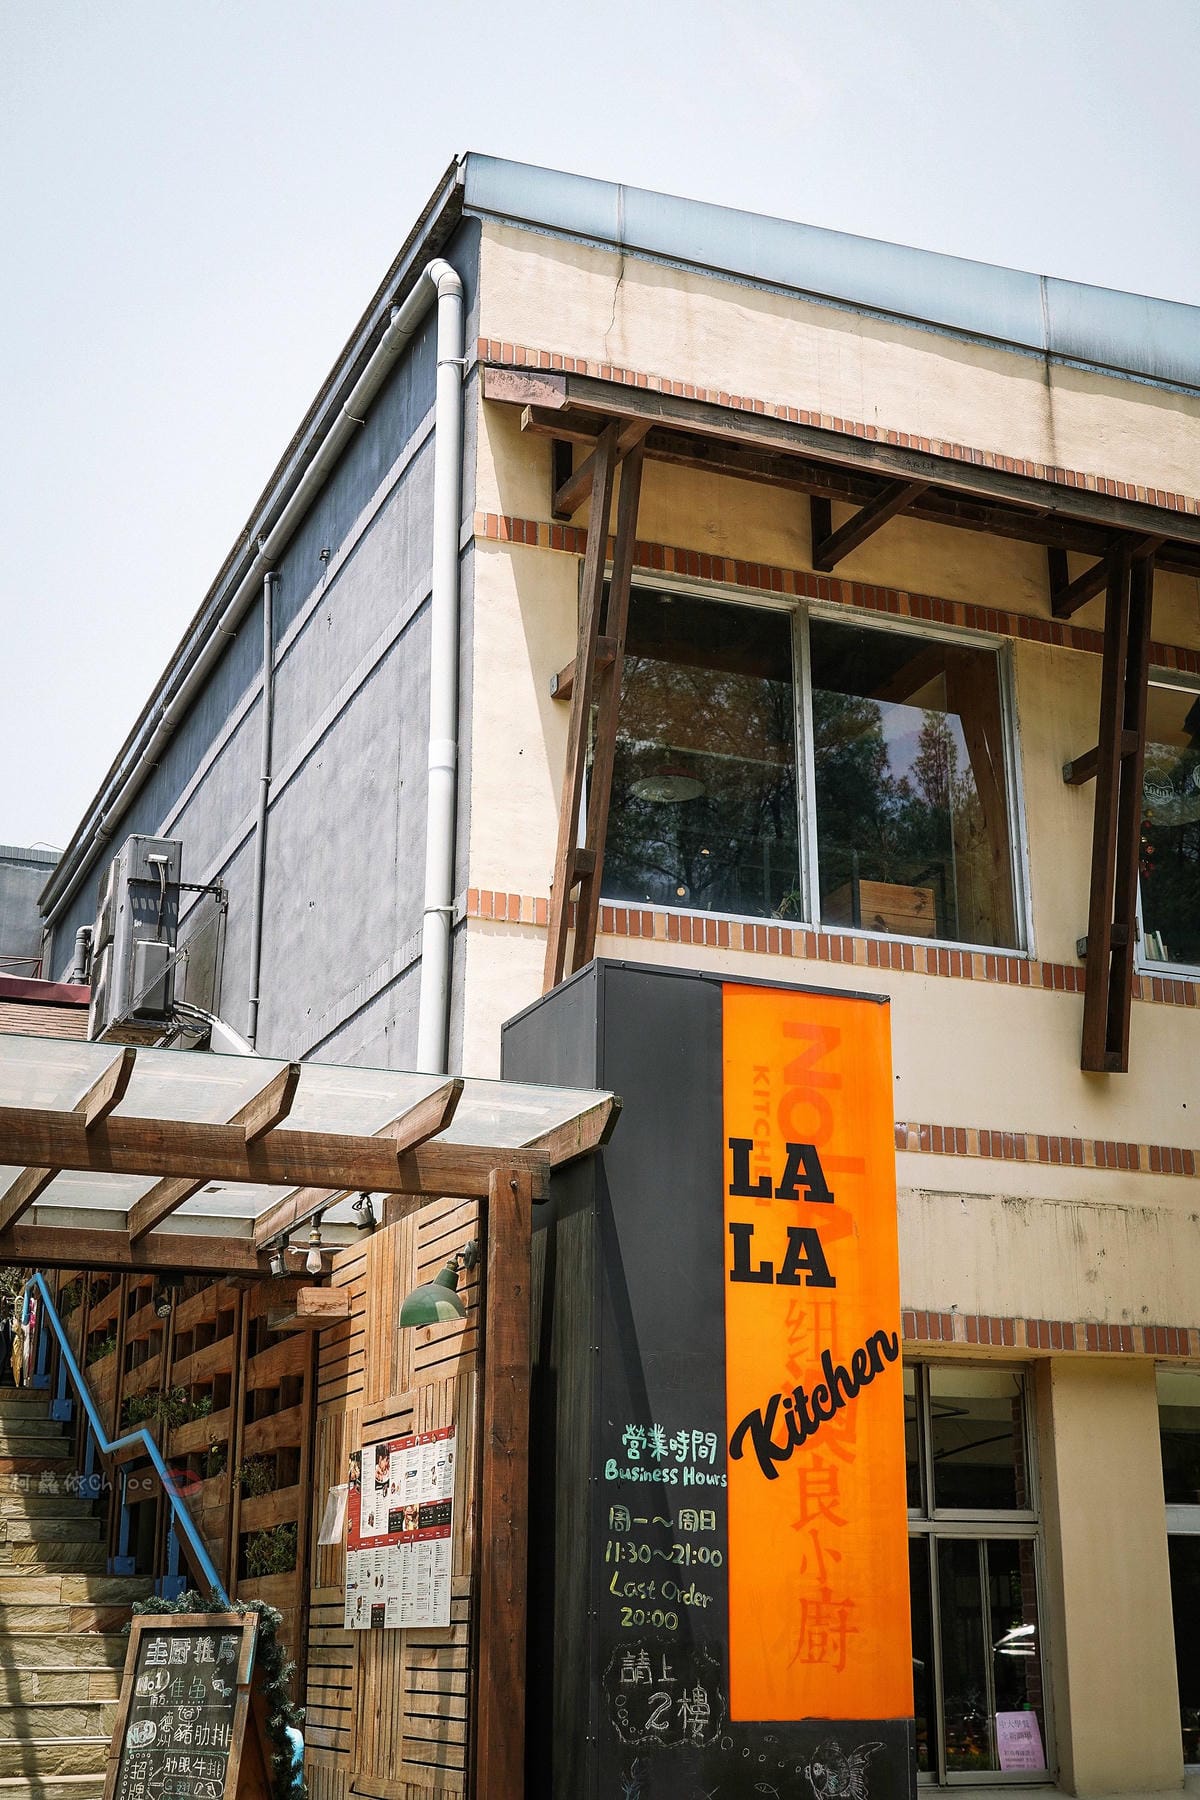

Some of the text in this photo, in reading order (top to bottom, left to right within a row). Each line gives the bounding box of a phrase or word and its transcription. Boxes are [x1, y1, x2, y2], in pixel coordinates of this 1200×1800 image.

[728, 1137, 834, 1204] LA
[729, 1222, 836, 1288] LA
[729, 1329, 898, 1480] Kitchen
[621, 1423, 718, 1465] 營業時間
[604, 1458, 728, 1488] Business Hours
[609, 1570, 714, 1609] Last Order
[620, 1606, 679, 1631] 20:00
[619, 1647, 679, 1685] 請上
